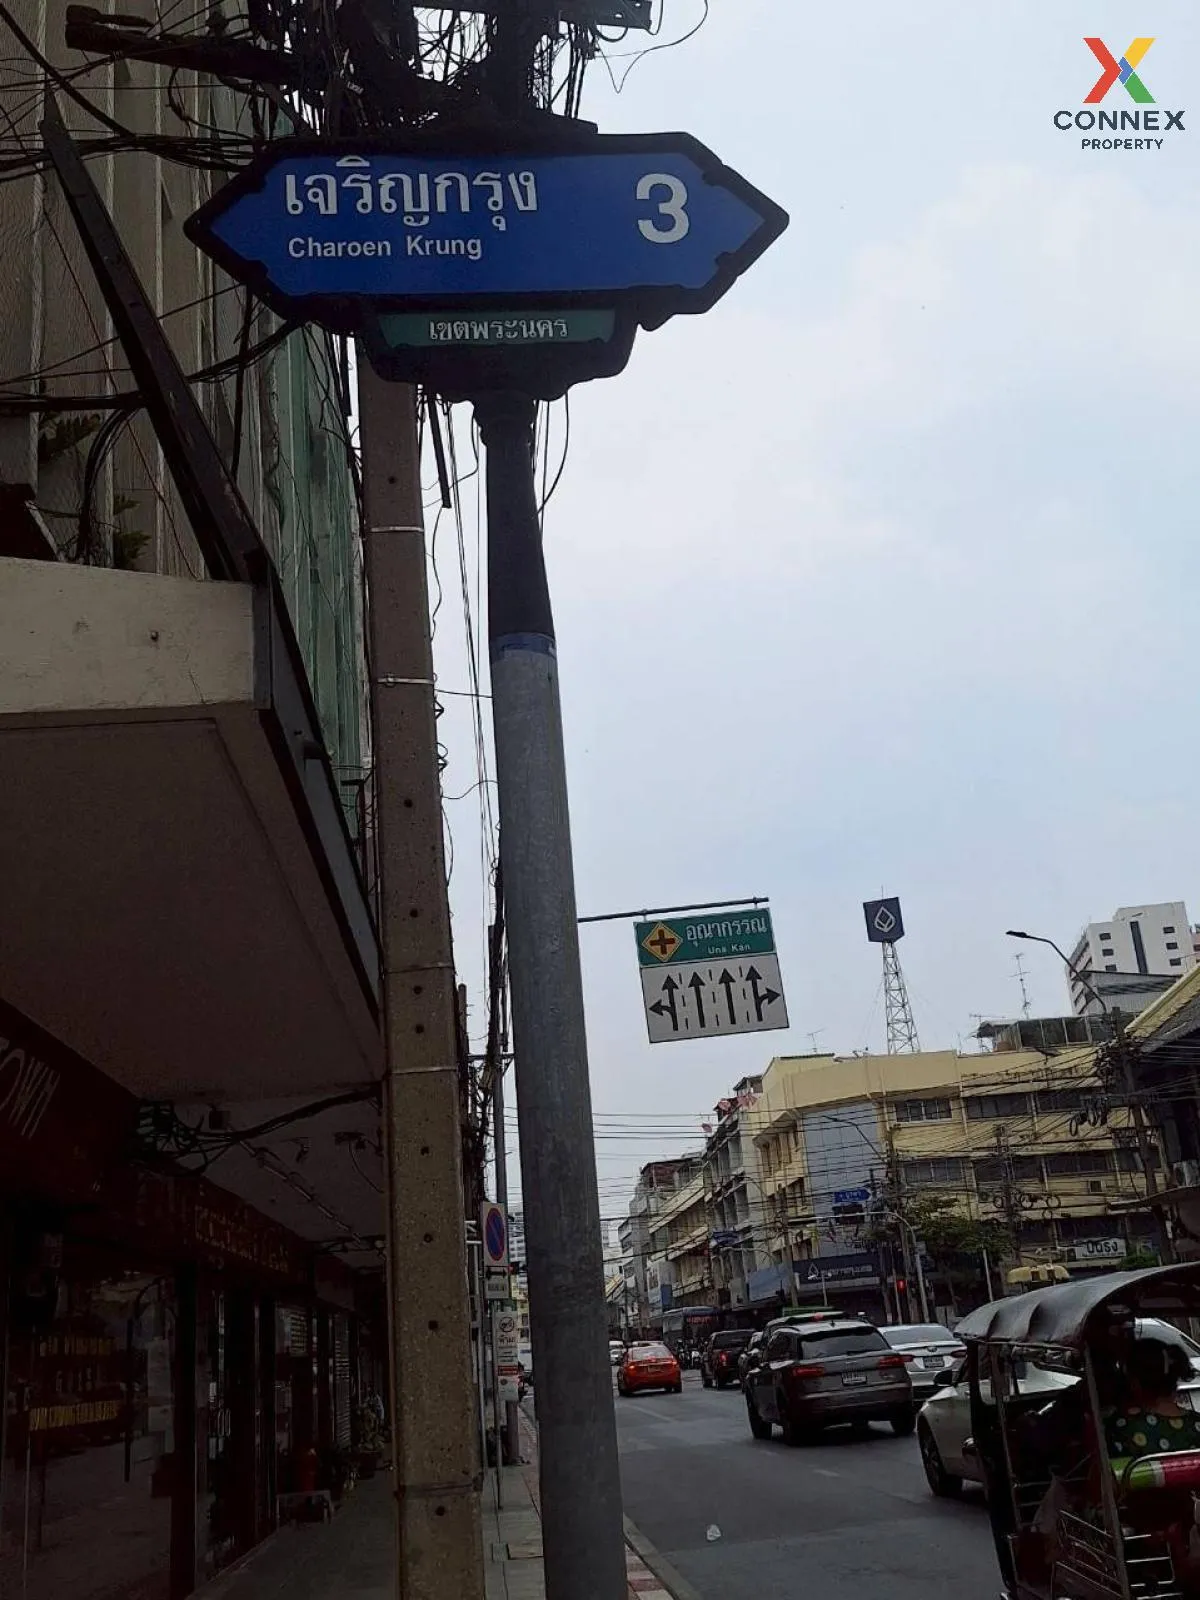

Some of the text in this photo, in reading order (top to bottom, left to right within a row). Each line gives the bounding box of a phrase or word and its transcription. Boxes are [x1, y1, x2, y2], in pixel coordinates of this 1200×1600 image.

[285, 156, 538, 231] เจริญกรุง
[635, 173, 691, 243] 3
[288, 236, 483, 260] Charoen Krung
[429, 318, 569, 341] เขตพระนคร
[686, 917, 768, 946] อุณากรรณ
[731, 943, 751, 952] Kan
[0, 1037, 61, 1140] OWN
